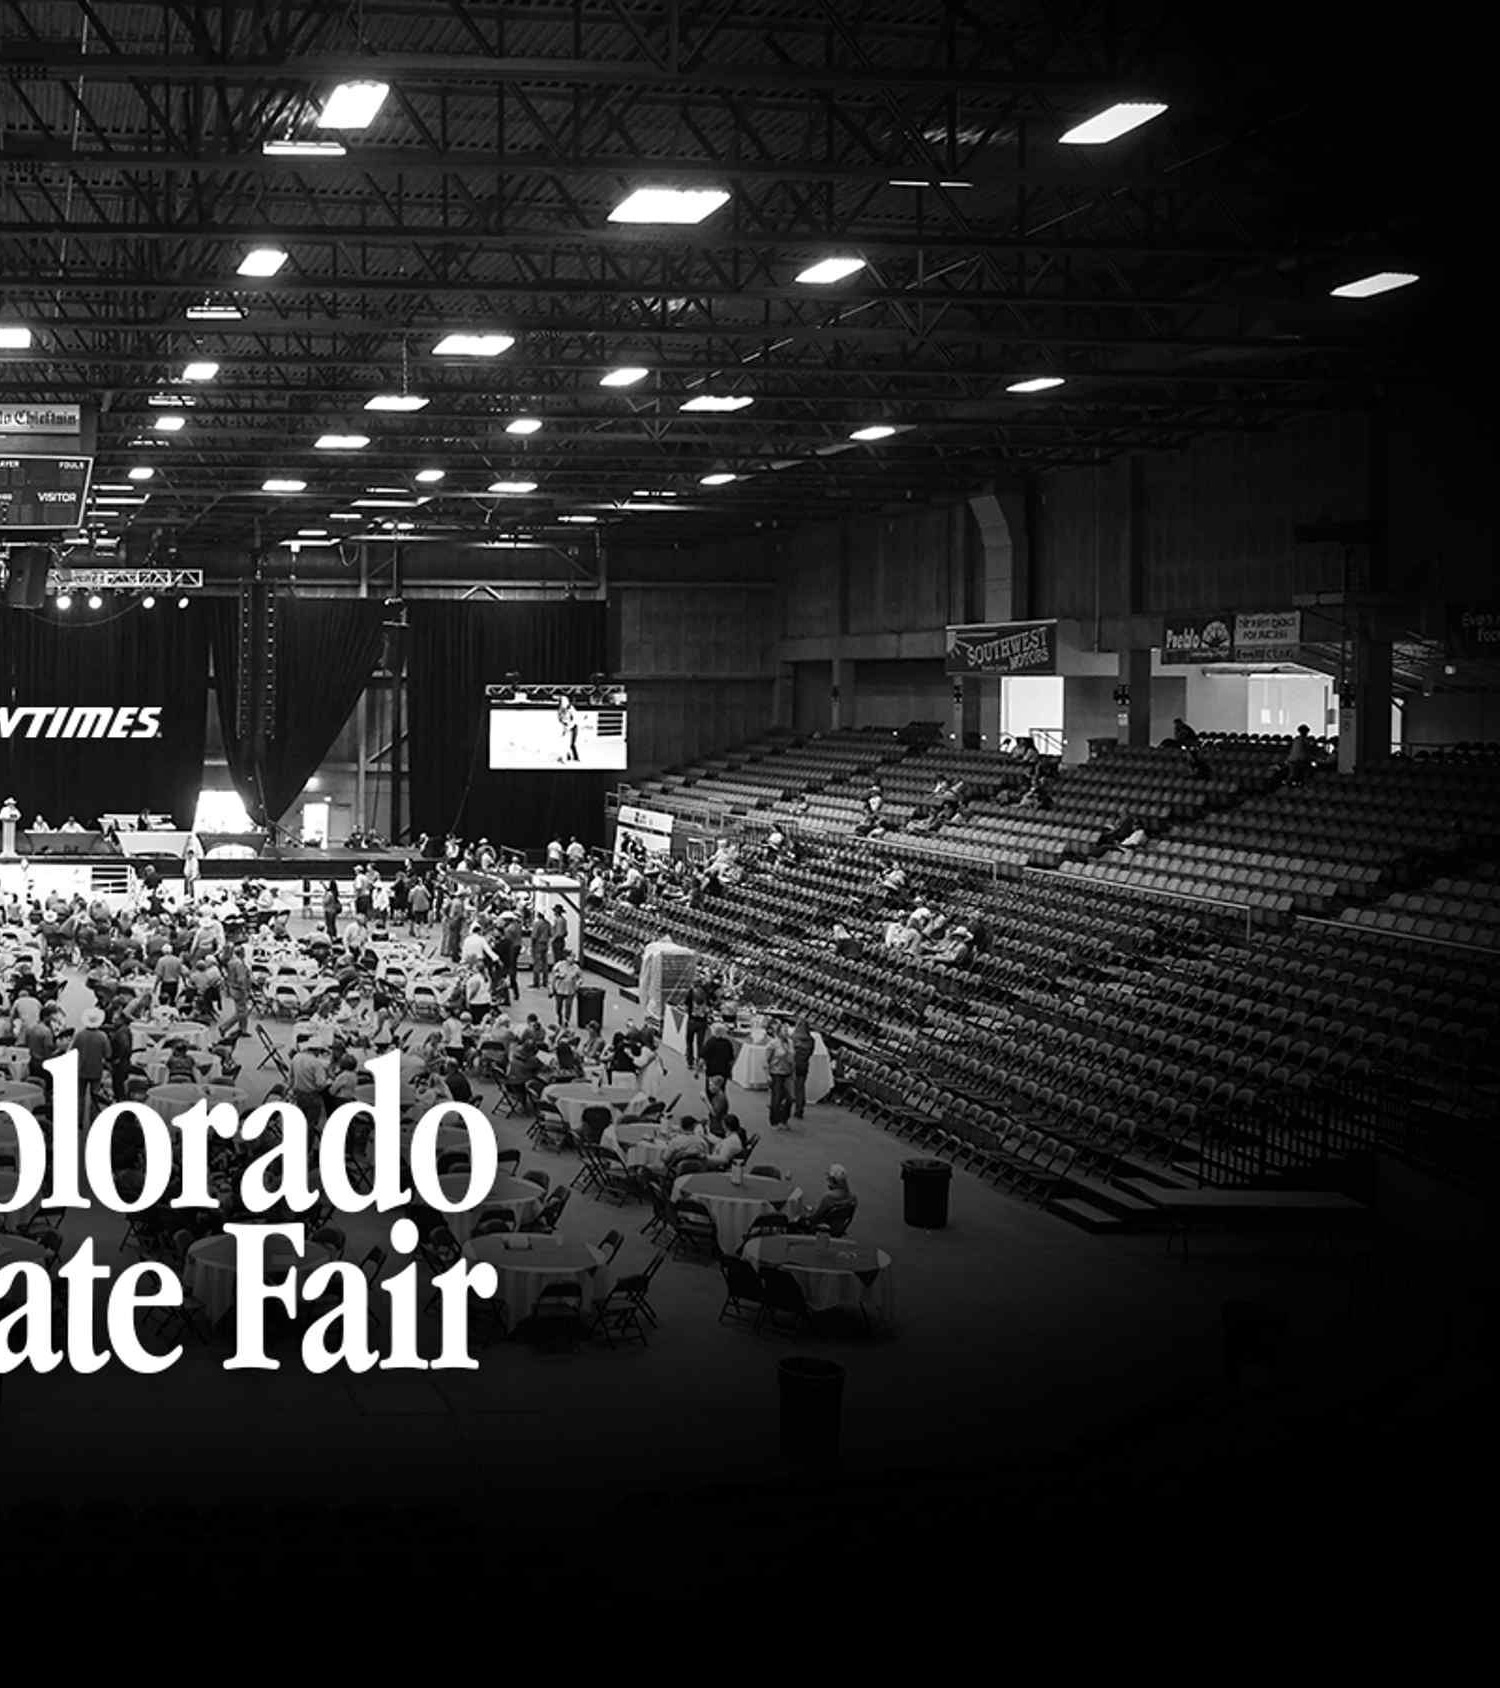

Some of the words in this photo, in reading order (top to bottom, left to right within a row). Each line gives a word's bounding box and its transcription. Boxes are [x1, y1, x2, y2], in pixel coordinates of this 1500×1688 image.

[14, 409, 77, 426] Chieftain
[59, 461, 85, 470] FOULS
[37, 492, 77, 502] VISITOR
[966, 626, 1048, 667] SOUTHWEST
